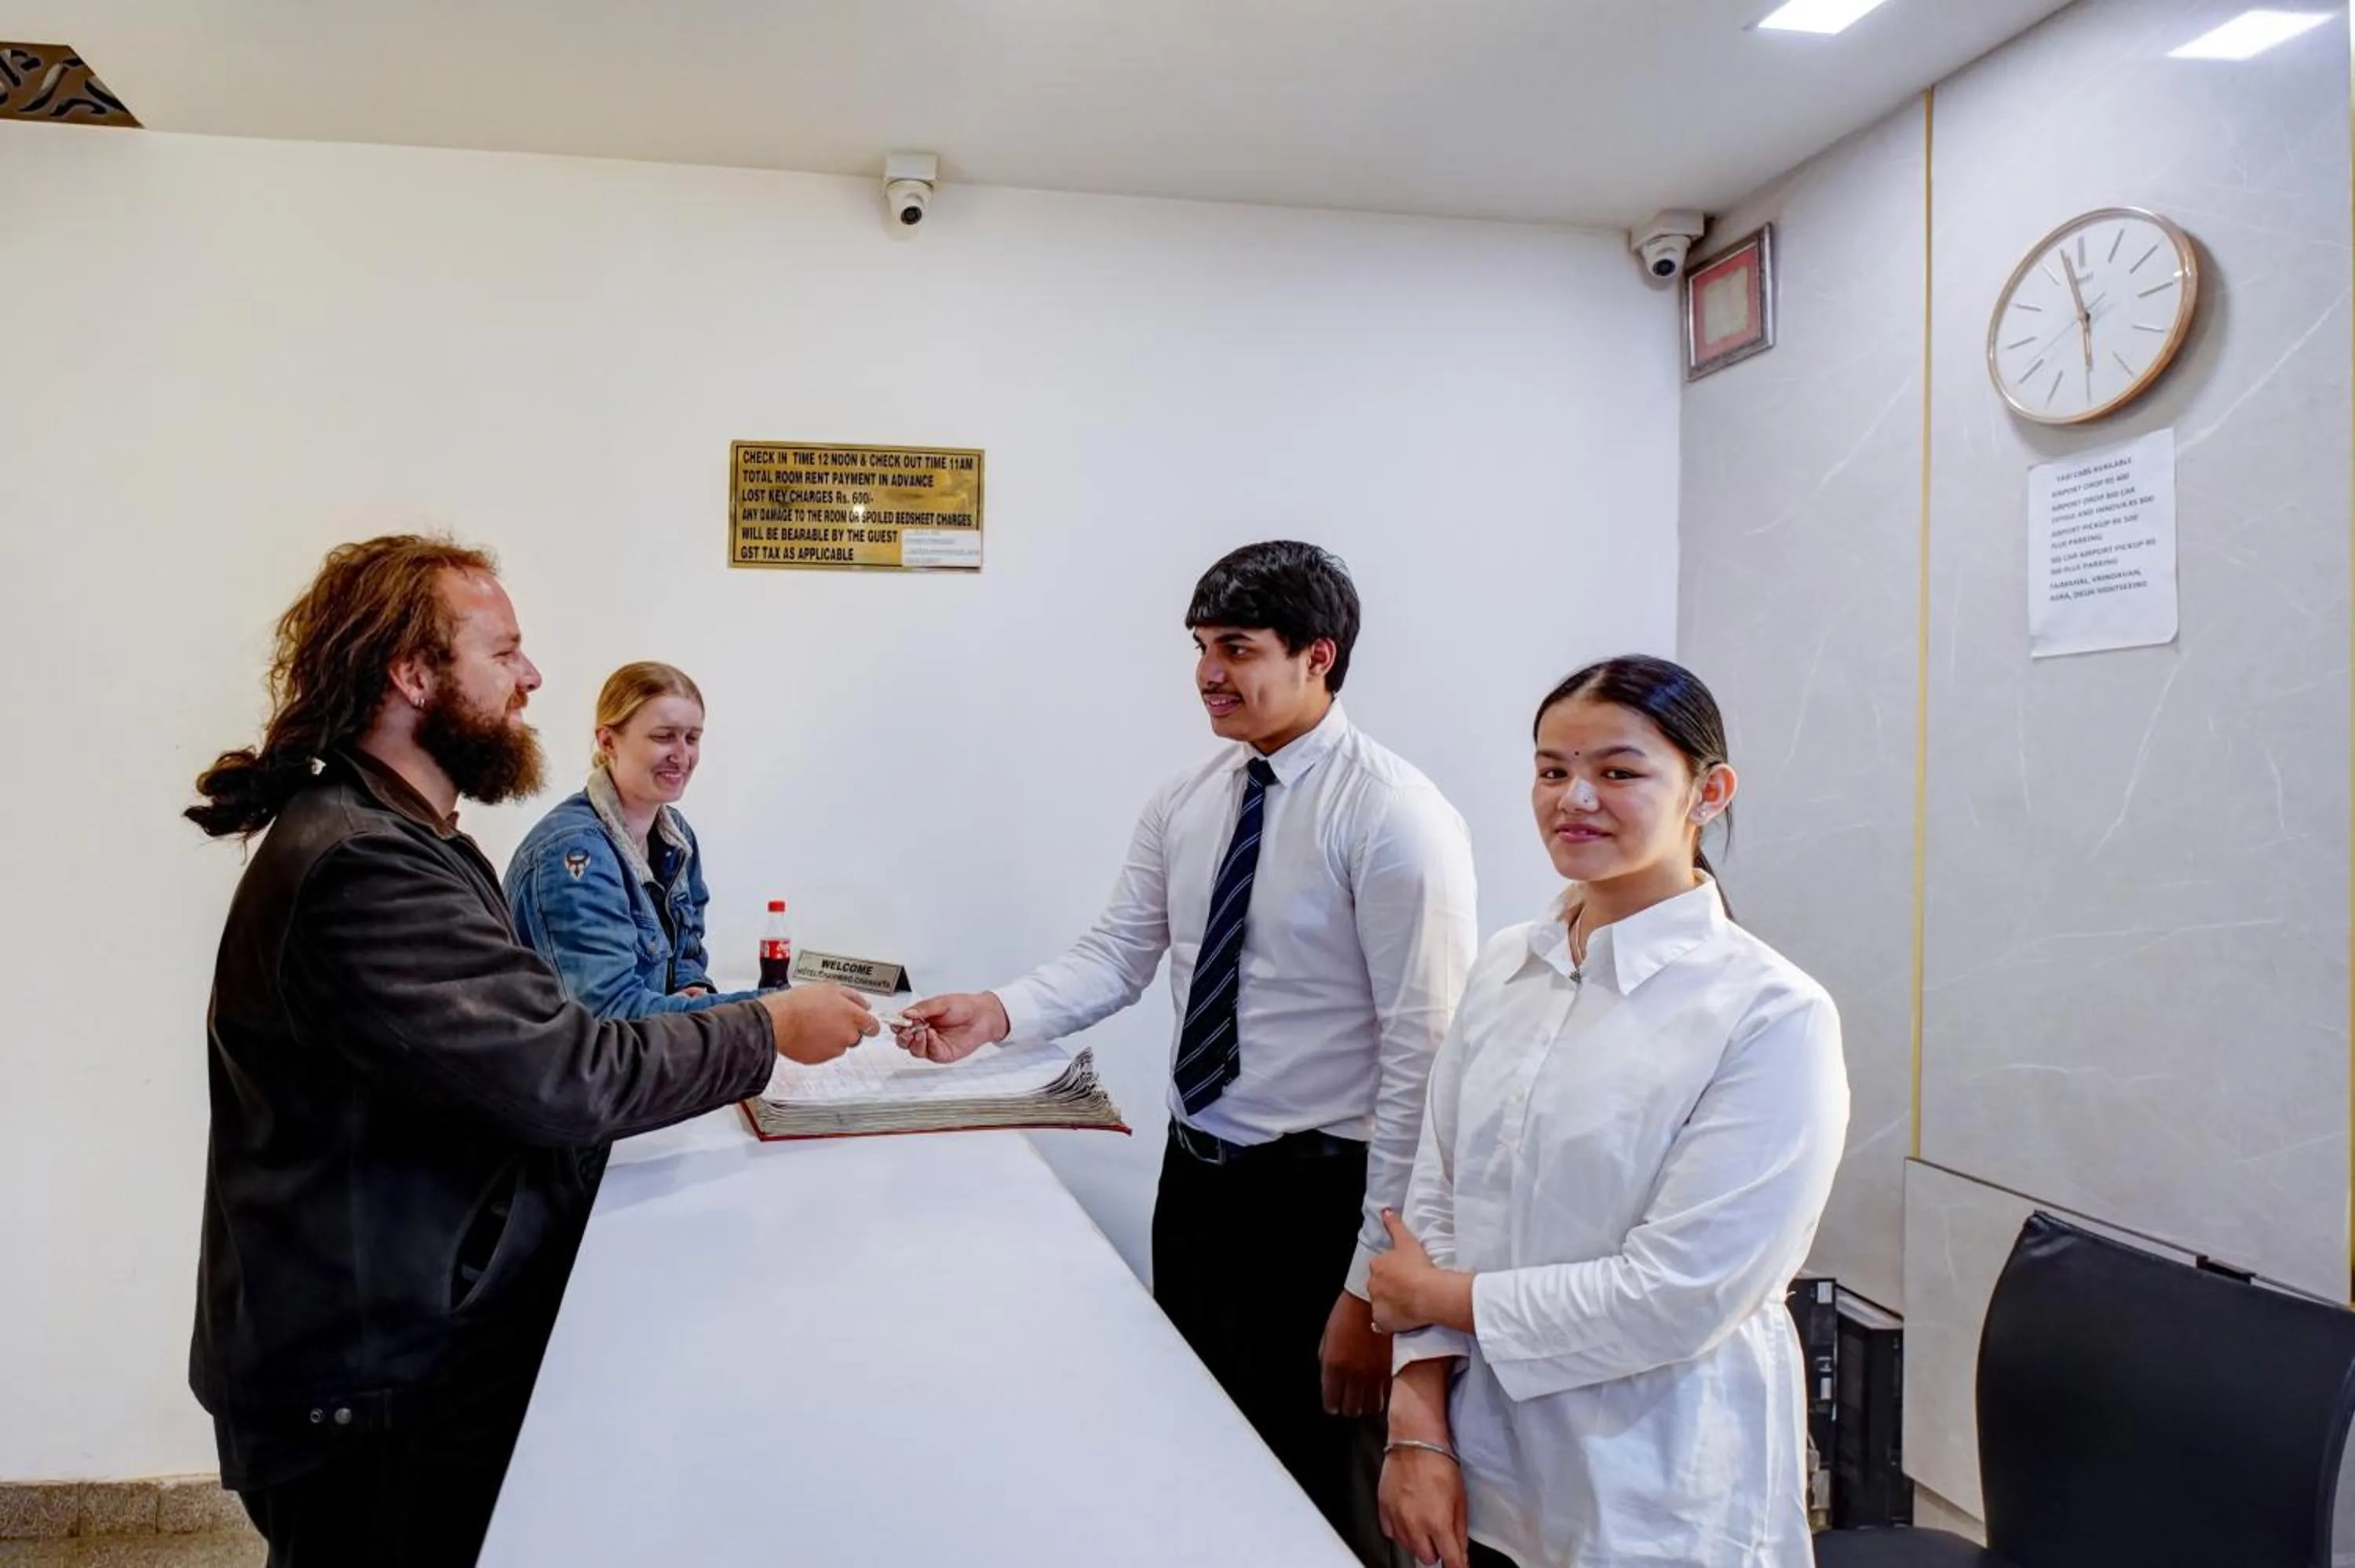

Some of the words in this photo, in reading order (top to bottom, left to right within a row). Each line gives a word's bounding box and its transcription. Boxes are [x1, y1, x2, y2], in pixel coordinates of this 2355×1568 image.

[743, 450, 775, 464] CHECK
[779, 451, 787, 465] IN
[793, 452, 815, 465] TIME
[818, 453, 828, 465] 12
[831, 454, 857, 466] NOON
[860, 454, 867, 466] &
[869, 454, 900, 468] CHECK
[904, 455, 922, 469] OUT
[926, 456, 947, 469] TIME
[950, 458, 973, 470] 11AM
[743, 469, 772, 483] TOTAL
[775, 471, 802, 483] ROOM
[805, 472, 829, 484] RENT
[832, 472, 875, 486] PAYMENT
[878, 473, 888, 486] IN
[891, 474, 933, 487] ADVANCE
[742, 489, 765, 501] LOST
[769, 490, 787, 503] KEY
[789, 490, 834, 504] CHARGES
[836, 490, 850, 504] Rs.
[742, 509, 758, 520] ANY
[760, 509, 792, 521] DAMAGE
[795, 509, 805, 521] TO
[808, 509, 822, 522] THE
[825, 510, 847, 522] ROOM
[849, 510, 860, 523] OR
[862, 511, 893, 523] SPOILED
[896, 512, 934, 525] BEDSHEET
[937, 512, 972, 526] CHARGES
[741, 527, 763, 540] WILL
[766, 527, 779, 540] BE
[781, 527, 829, 542] BEARABLE
[831, 528, 844, 542] BY
[847, 529, 865, 542] THE
[867, 530, 897, 543] GUEST
[740, 545, 759, 559] GST
[762, 546, 781, 560] TAX
[783, 546, 795, 560] AS
[797, 547, 854, 561] APPLICABLE
[822, 958, 873, 975] WELCOME
